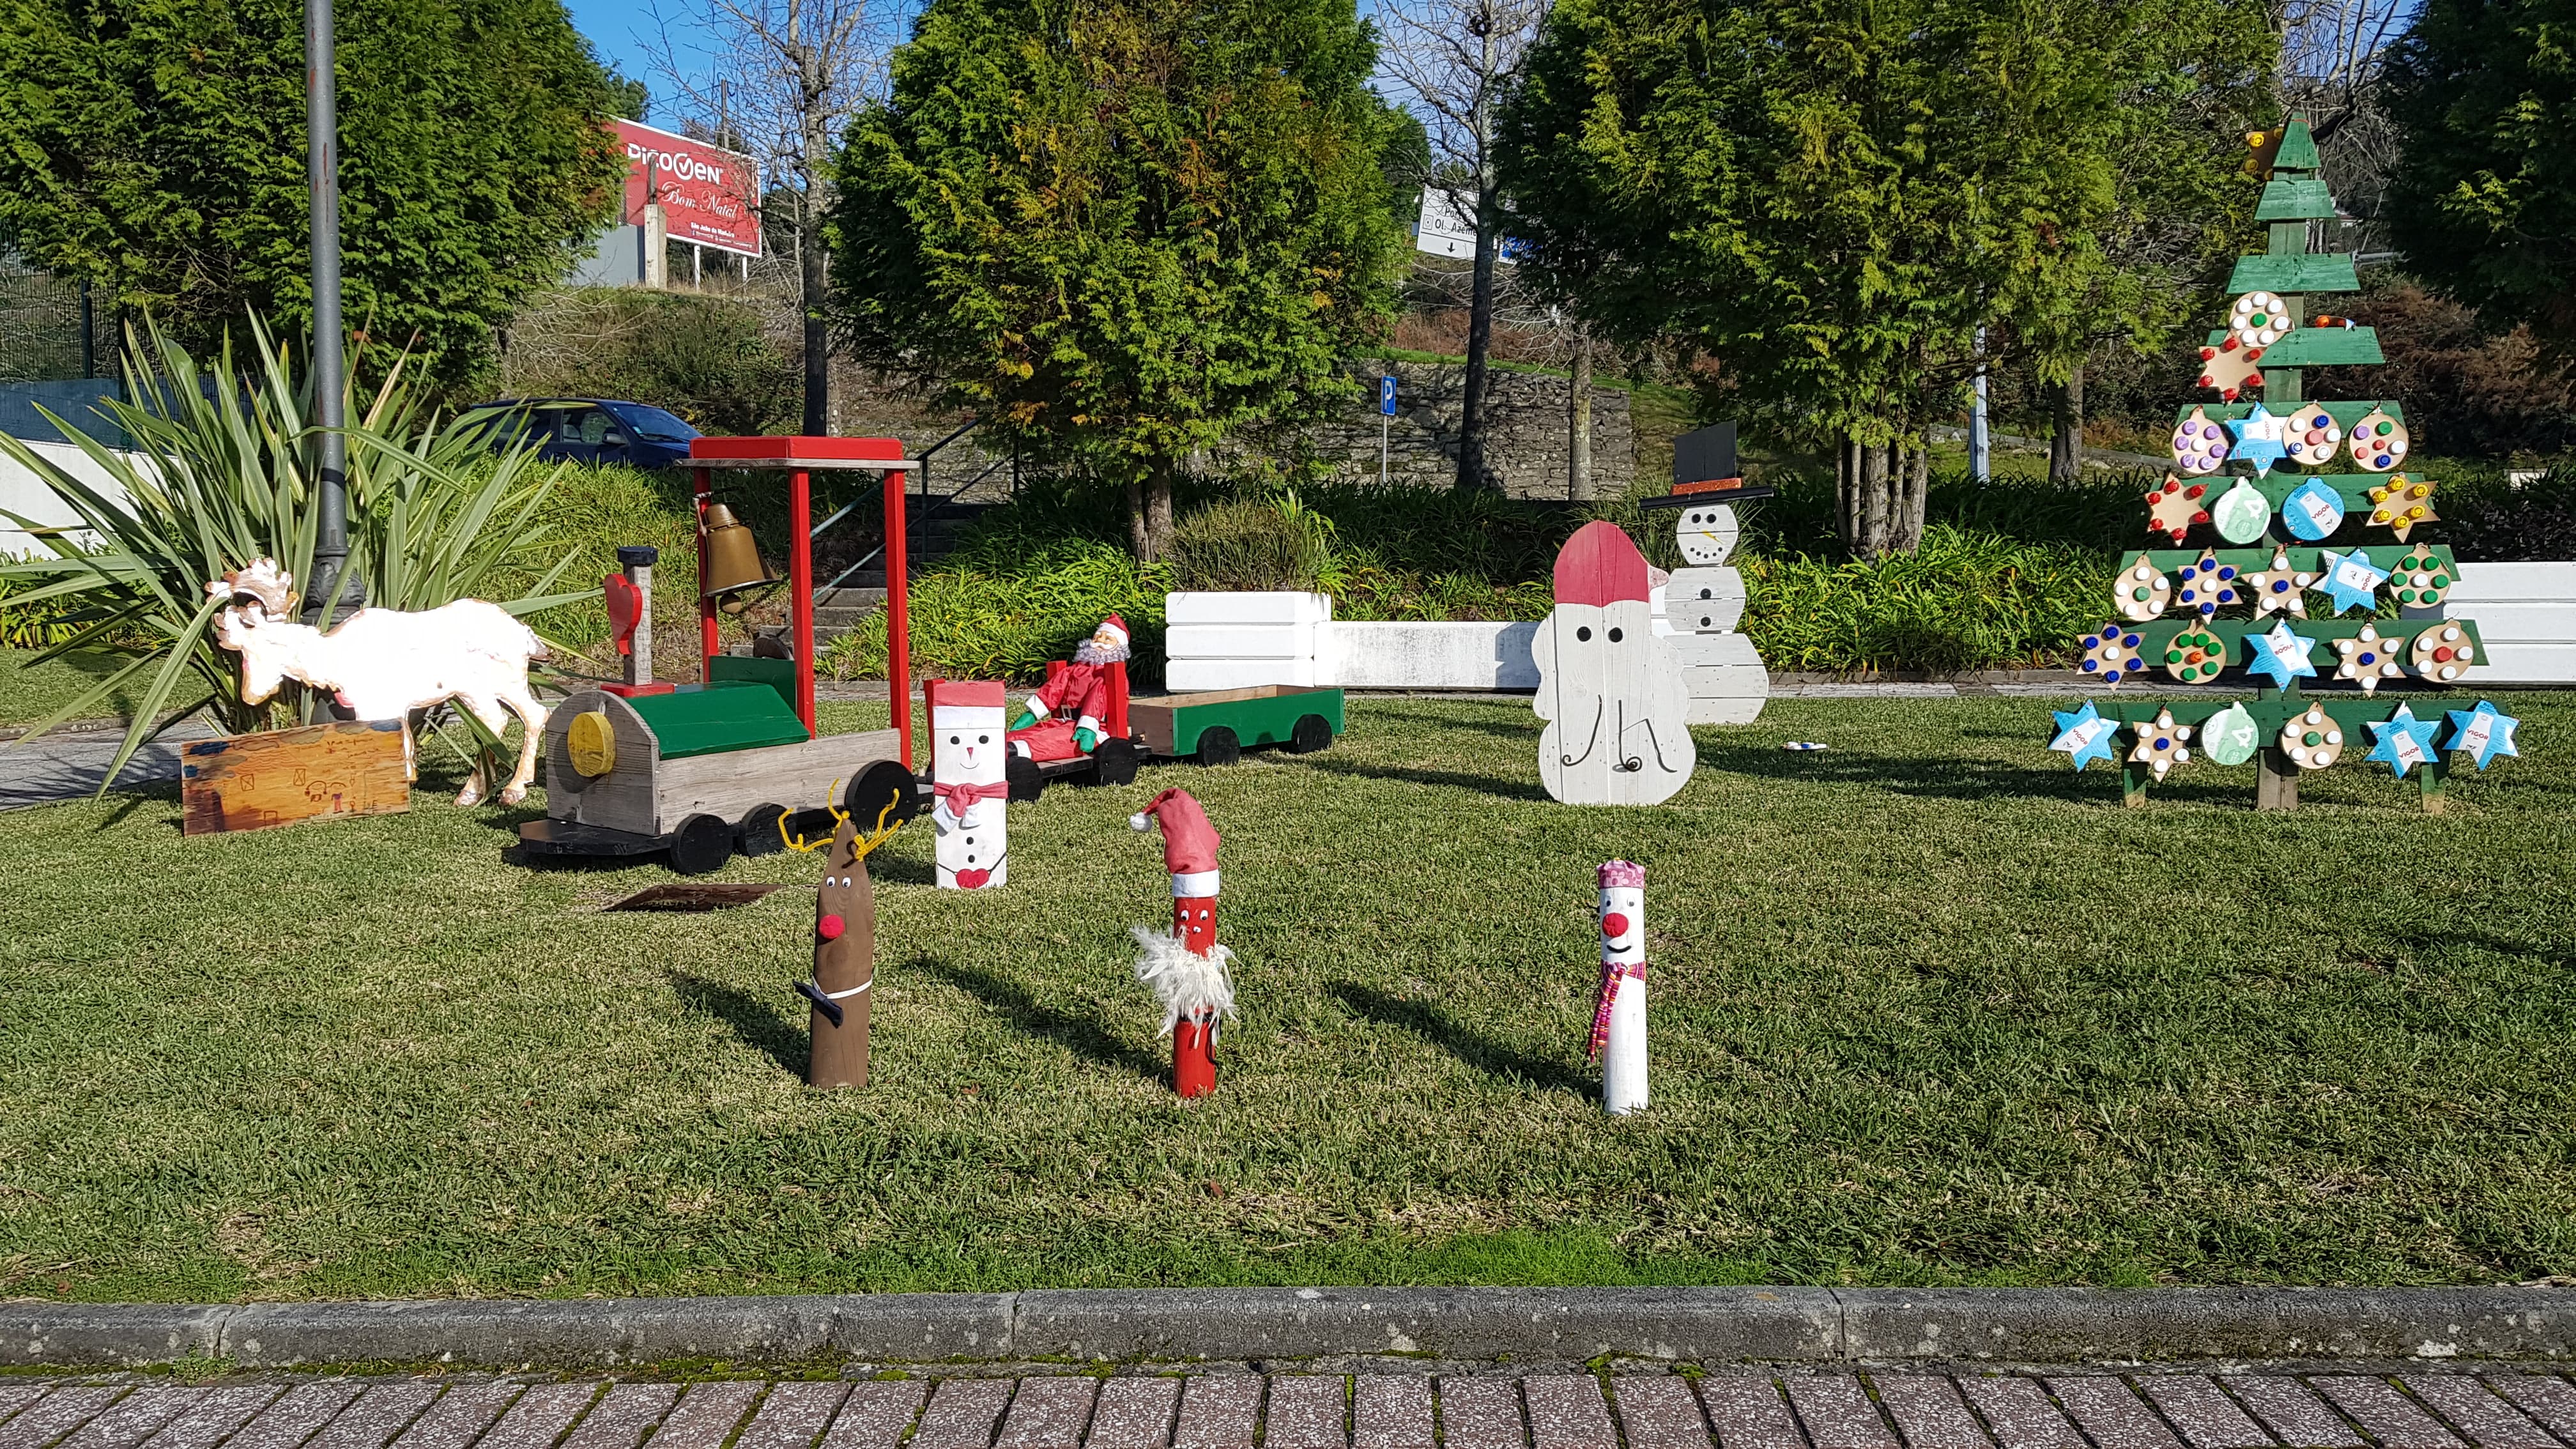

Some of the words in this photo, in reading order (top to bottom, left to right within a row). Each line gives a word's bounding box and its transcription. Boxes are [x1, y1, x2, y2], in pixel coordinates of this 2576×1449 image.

[662, 181, 696, 208] Bom
[700, 190, 739, 218] Natal
[1435, 218, 1446, 231] Ol.
[1384, 380, 1393, 410] P
[2312, 504, 2331, 519] VIGOR
[2361, 572, 2373, 591] VIGOR
[2274, 644, 2295, 655] VIGOR
[2073, 728, 2089, 746] VIGOR
[2467, 728, 2489, 740] VIGOR
[2398, 746, 2419, 758] VIGOR
